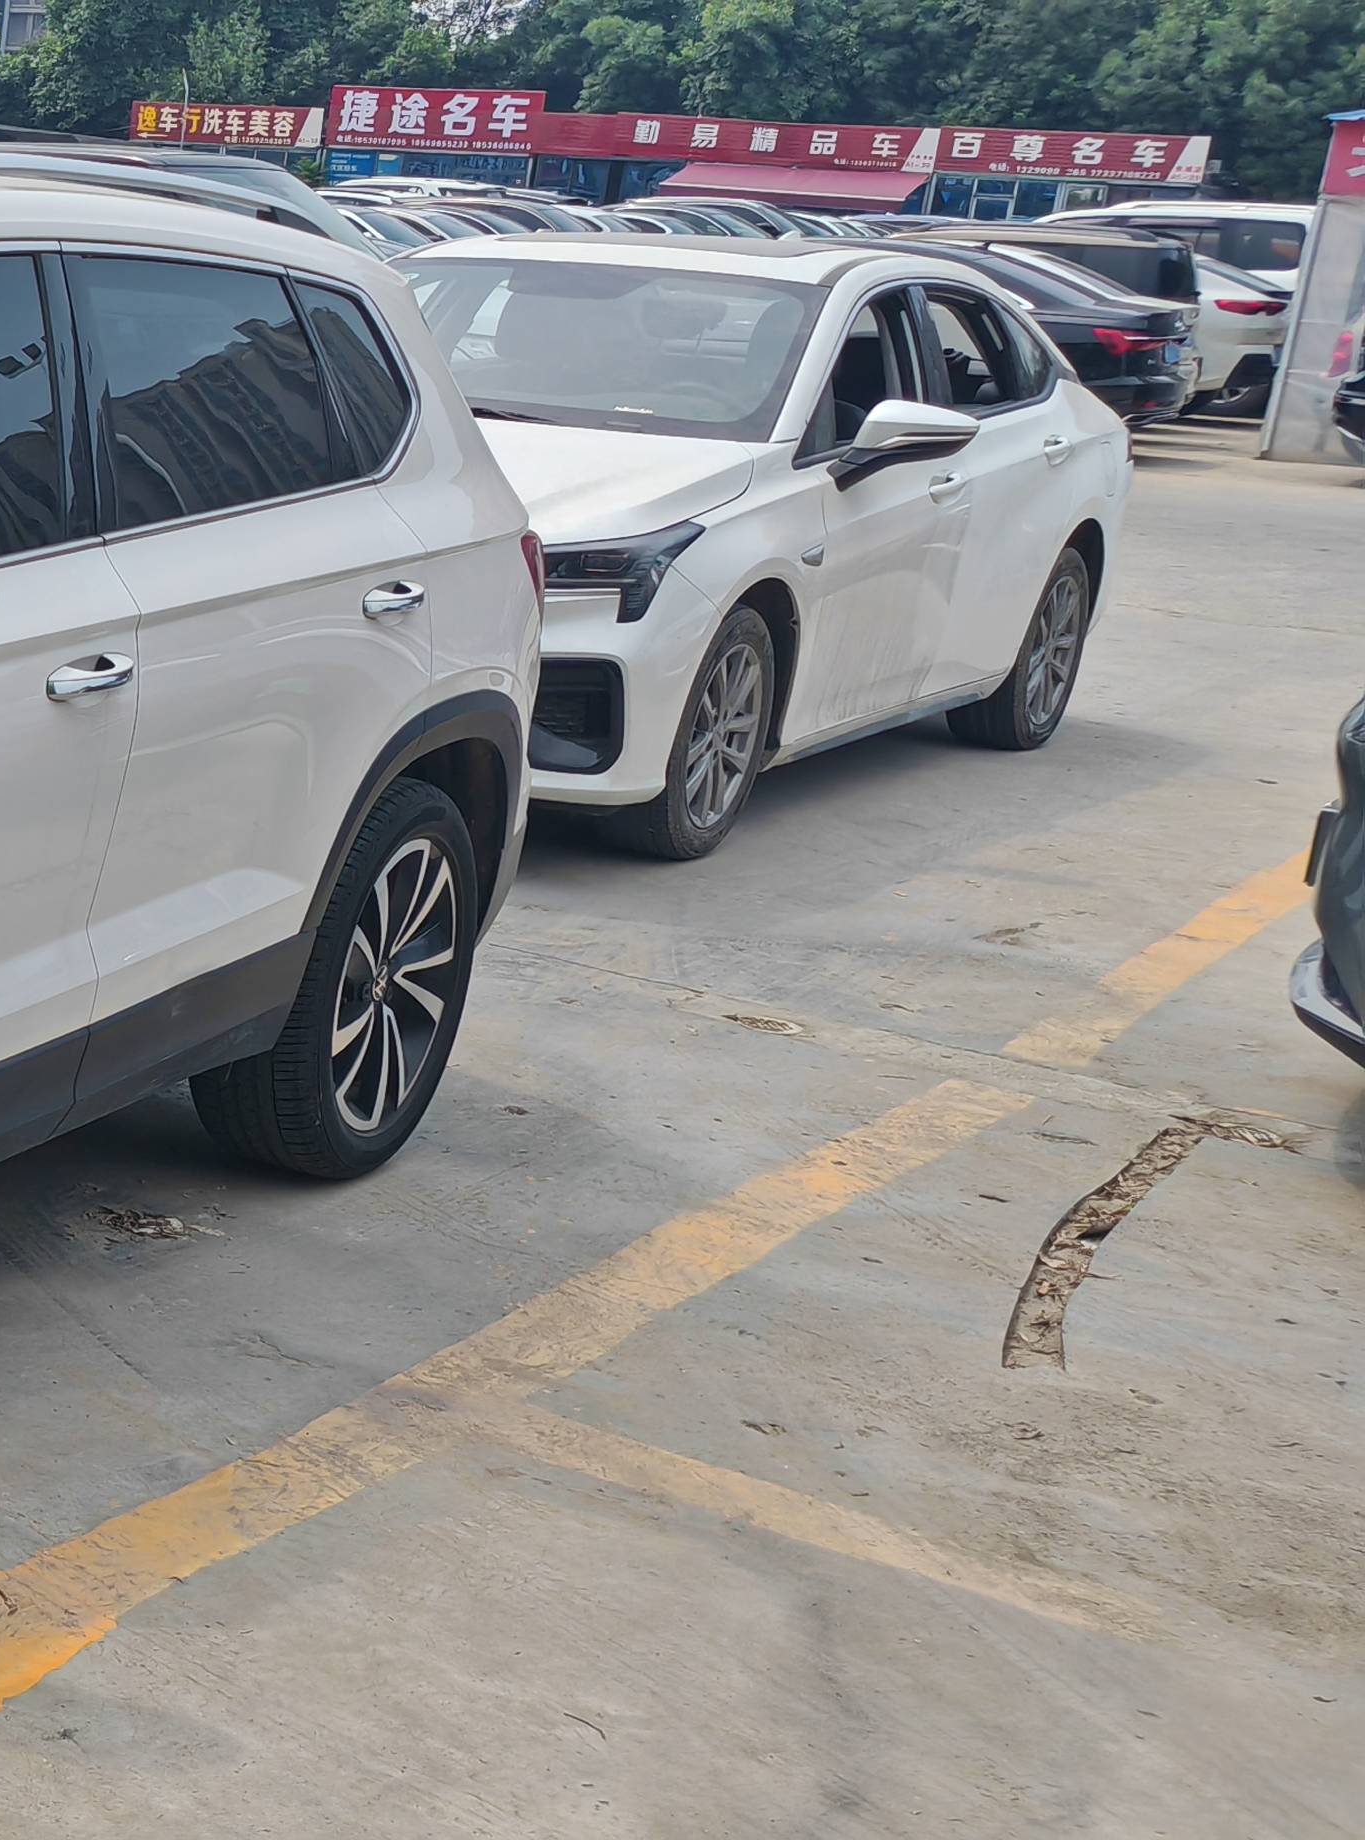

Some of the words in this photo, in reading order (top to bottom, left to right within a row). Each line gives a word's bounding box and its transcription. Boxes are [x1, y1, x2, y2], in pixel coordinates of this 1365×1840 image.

[338, 90, 531, 138] 捷途名车
[632, 119, 902, 158] 勤易精品车
[951, 132, 1169, 168] 百尊名车
